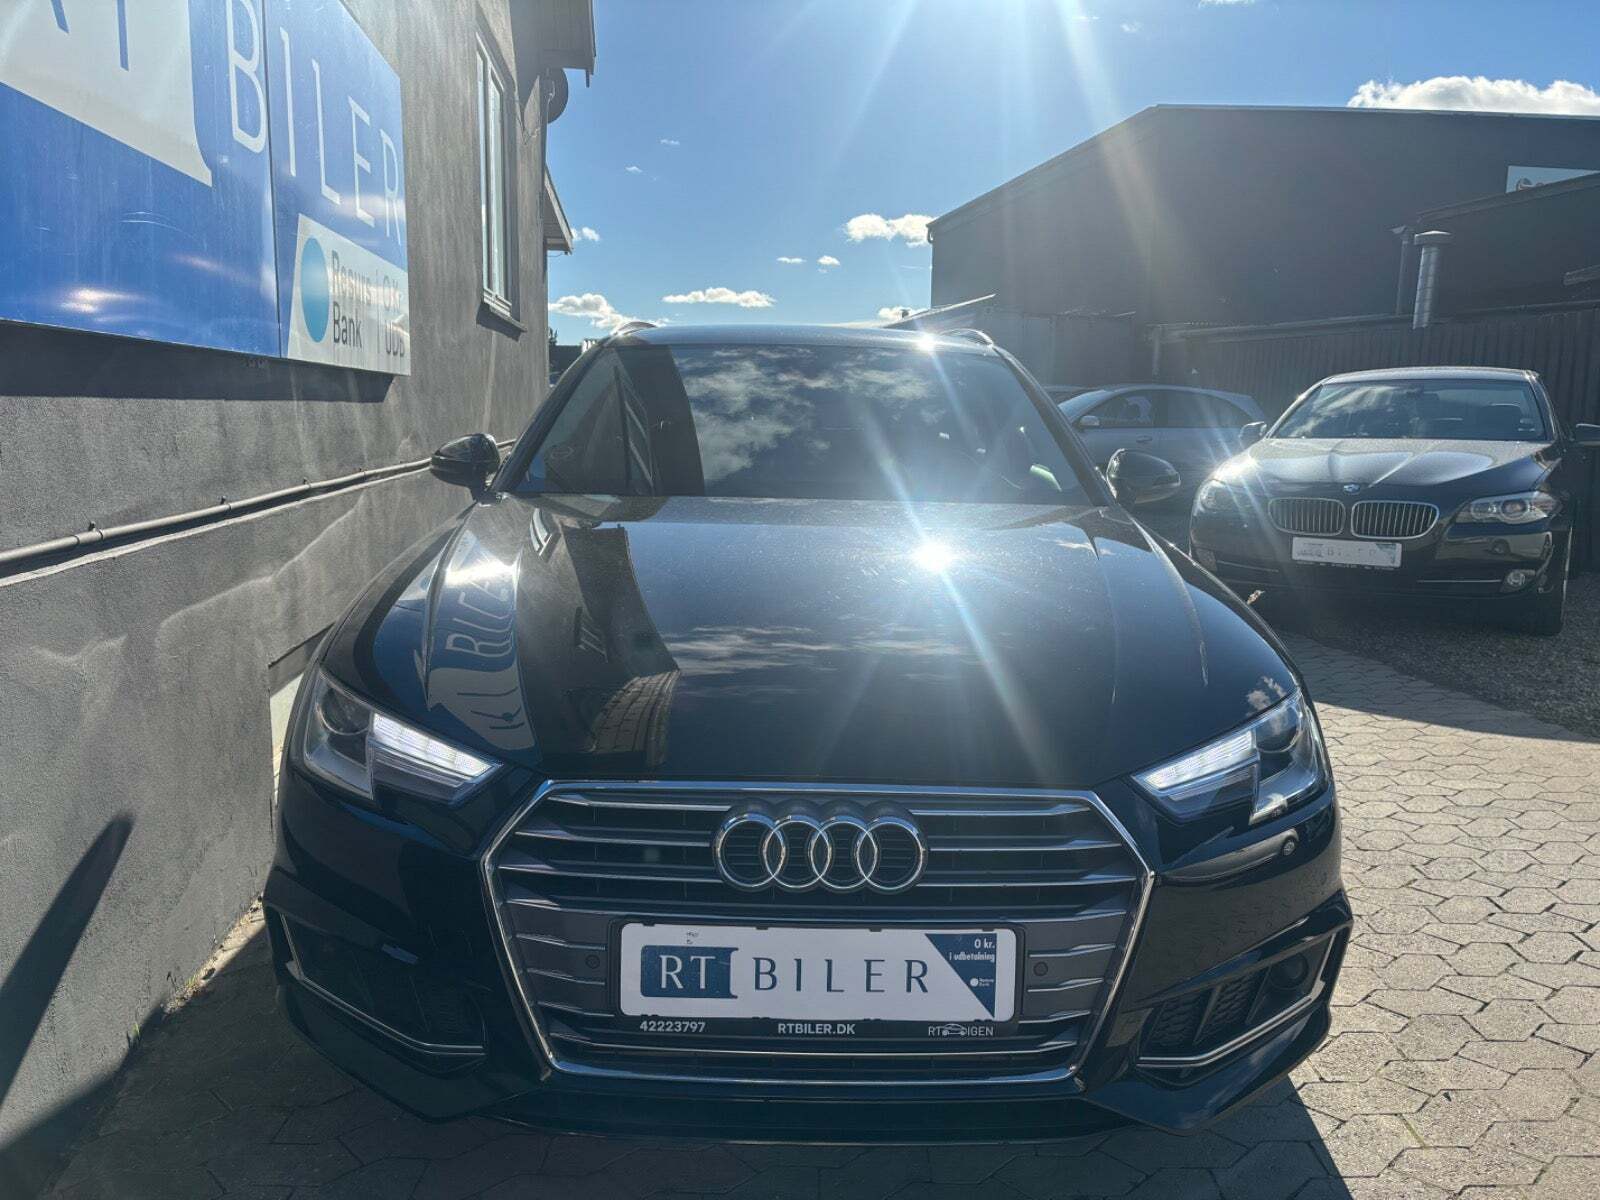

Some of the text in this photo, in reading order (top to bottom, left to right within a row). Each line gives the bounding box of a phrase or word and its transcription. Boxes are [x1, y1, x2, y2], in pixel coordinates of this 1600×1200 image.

[226, 0, 401, 246] BILER
[333, 301, 362, 348] Bank
[974, 938, 996, 949] 0 kr.
[659, 954, 929, 993] RT BILER
[640, 1020, 706, 1033] 42223797
[778, 1023, 856, 1035] RTBILER.DK
